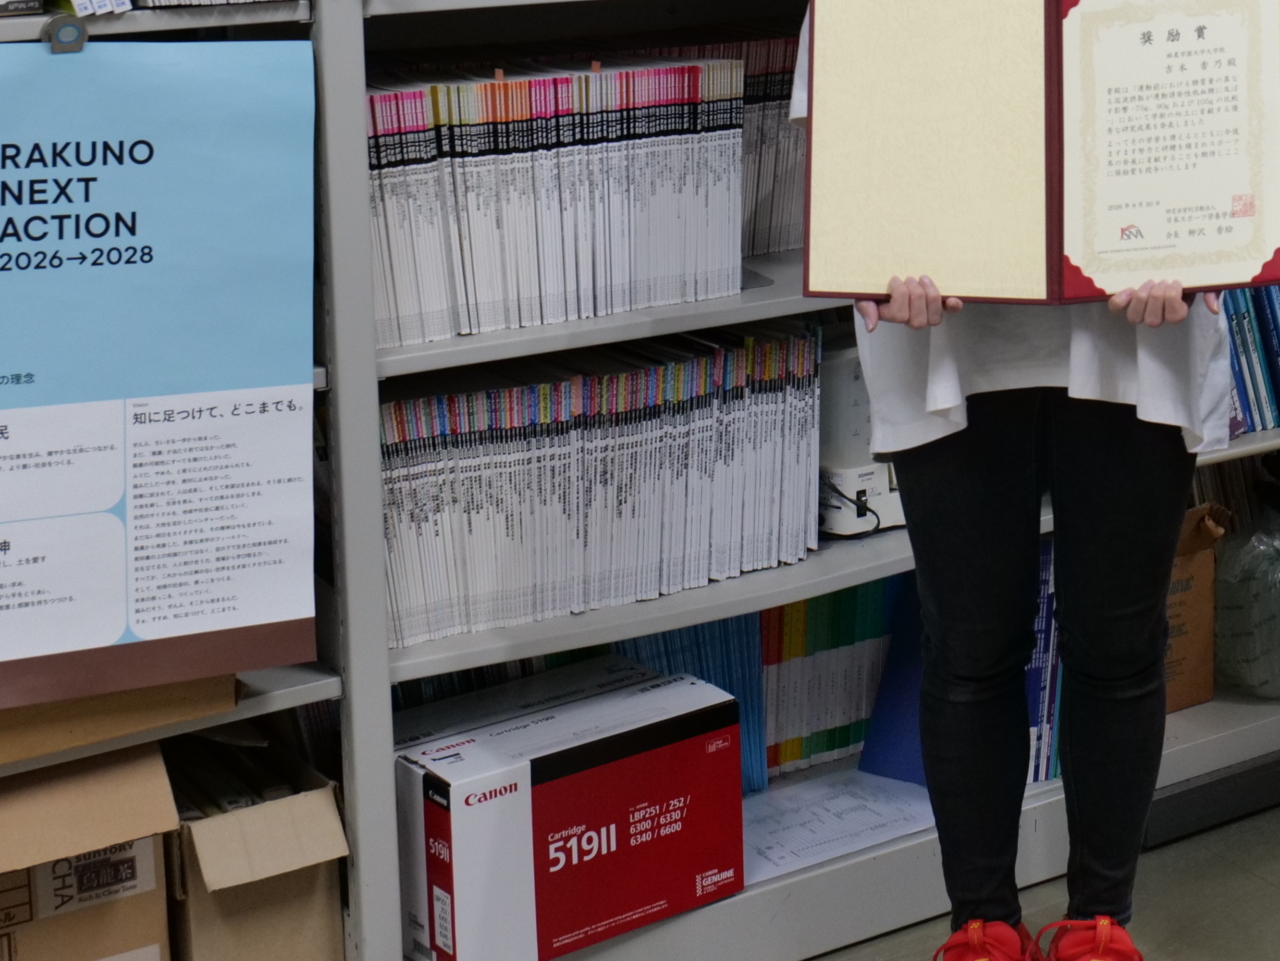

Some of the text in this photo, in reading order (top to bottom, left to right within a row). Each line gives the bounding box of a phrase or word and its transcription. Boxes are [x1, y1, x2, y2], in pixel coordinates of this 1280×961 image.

[1140, 25, 1207, 46] 奨励賞
[1, 140, 154, 169] RAKUNO
[1, 177, 97, 206] NEXT
[0, 212, 136, 243] ACTION
[133, 399, 303, 425] 知に足つけて、どこまでも。
[421, 738, 476, 756] Canon
[429, 789, 447, 806] Canon
[464, 782, 518, 807] Canon
[630, 805, 660, 823] LBP251
[669, 797, 684, 810] 252
[630, 821, 651, 834] 6300
[660, 811, 681, 825] 6330
[548, 824, 586, 842] Cartridge
[631, 832, 652, 846] 6340
[661, 822, 682, 836] 6600
[549, 823, 616, 873] 519II
[52, 857, 74, 911] CHA
[703, 868, 734, 886] GENUINE
